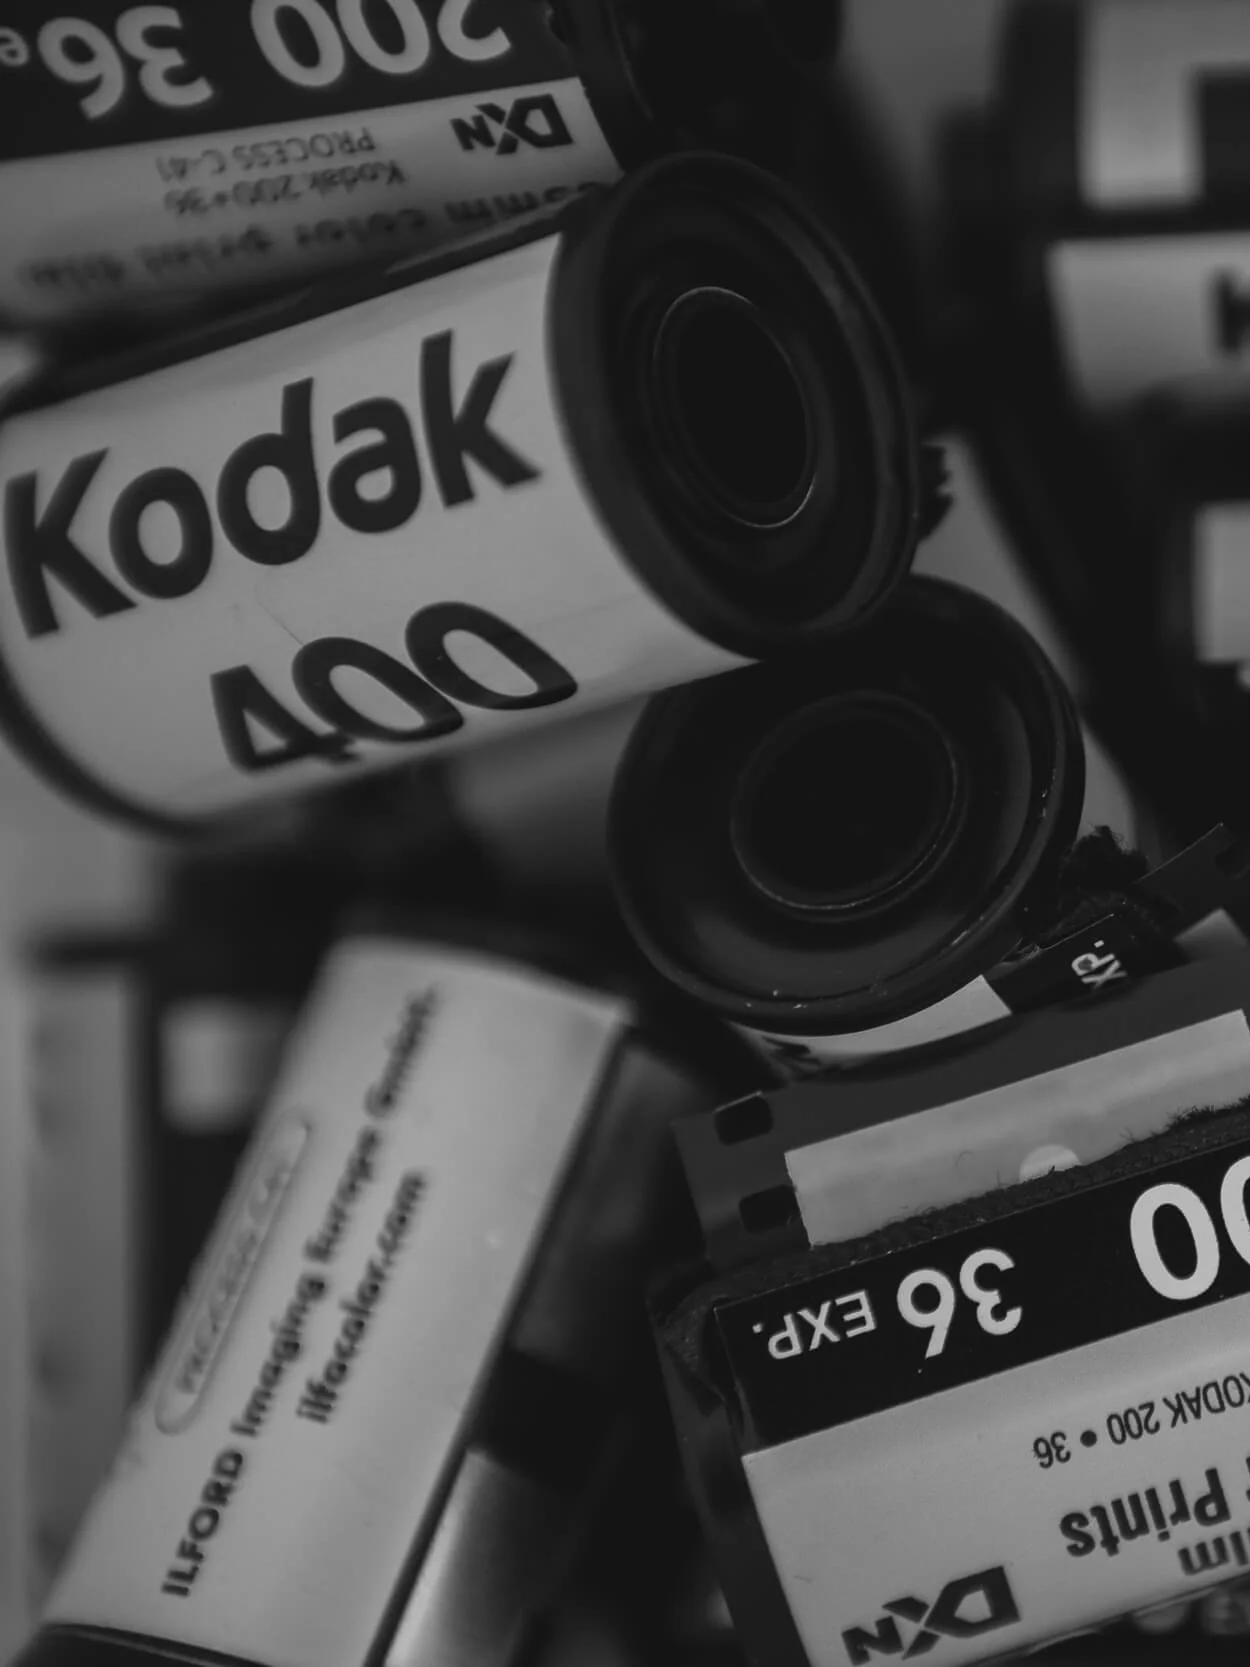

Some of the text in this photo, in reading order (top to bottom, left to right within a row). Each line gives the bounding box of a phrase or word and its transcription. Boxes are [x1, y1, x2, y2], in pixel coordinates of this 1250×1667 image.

[37, 6, 214, 121] 36
[250, 0, 512, 88] 200
[155, 127, 376, 182] PROCESS C-41
[309, 159, 405, 192] Kodak
[137, 226, 273, 277] print
[295, 207, 428, 245] color
[3, 328, 542, 639] Kodak
[210, 601, 579, 773] 400
[1070, 938, 1129, 991] XP.
[297, 1167, 428, 1424] ilfocolor.com
[751, 1290, 878, 1361] EXP.
[896, 1247, 1024, 1360] 36
[160, 1448, 244, 1598] ILFORD
[231, 1271, 327, 1437] Imaging
[306, 1128, 380, 1264] Europe
[1033, 1429, 1072, 1469] 36
[1107, 1400, 1160, 1447] 200
[1060, 1465, 1230, 1558] Prints
